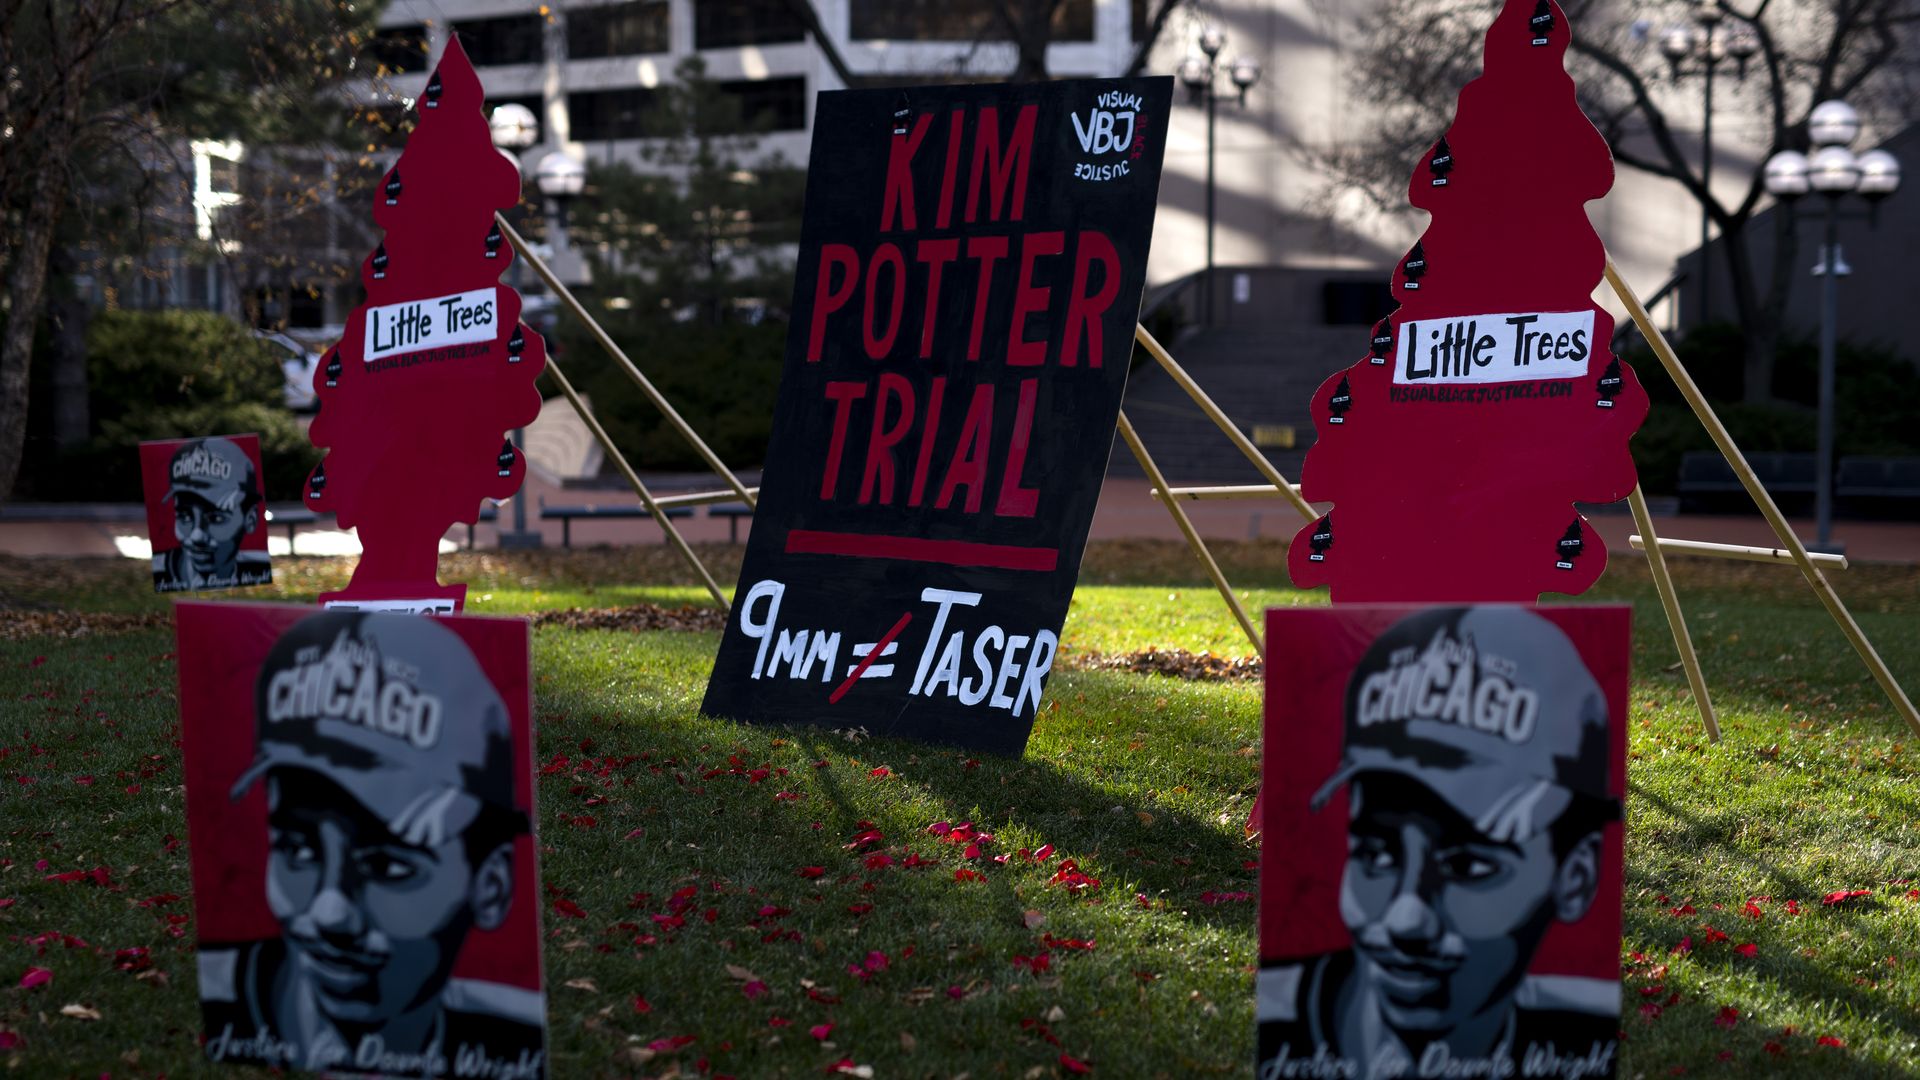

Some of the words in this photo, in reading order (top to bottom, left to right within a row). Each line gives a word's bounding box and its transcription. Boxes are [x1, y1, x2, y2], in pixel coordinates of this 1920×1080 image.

[1070, 107, 1135, 154] VBJ
[1097, 90, 1142, 112] VISUAL
[1130, 114, 1148, 160] BLACK
[880, 104, 1038, 232] KIM
[1074, 160, 1130, 181] JUSTICE
[373, 303, 432, 352] Little
[439, 296, 493, 334] Trees
[806, 230, 1121, 368] POTTER
[1405, 320, 1497, 380] Little
[1506, 314, 1588, 367] Trees
[172, 455, 232, 479] CHICAGO
[820, 373, 1039, 518] TRIAL
[909, 587, 1059, 717] TASER
[267, 660, 443, 749] CHICAGO
[1357, 660, 1540, 743] CHICAGO
[1259, 1041, 1359, 1080] Justice
